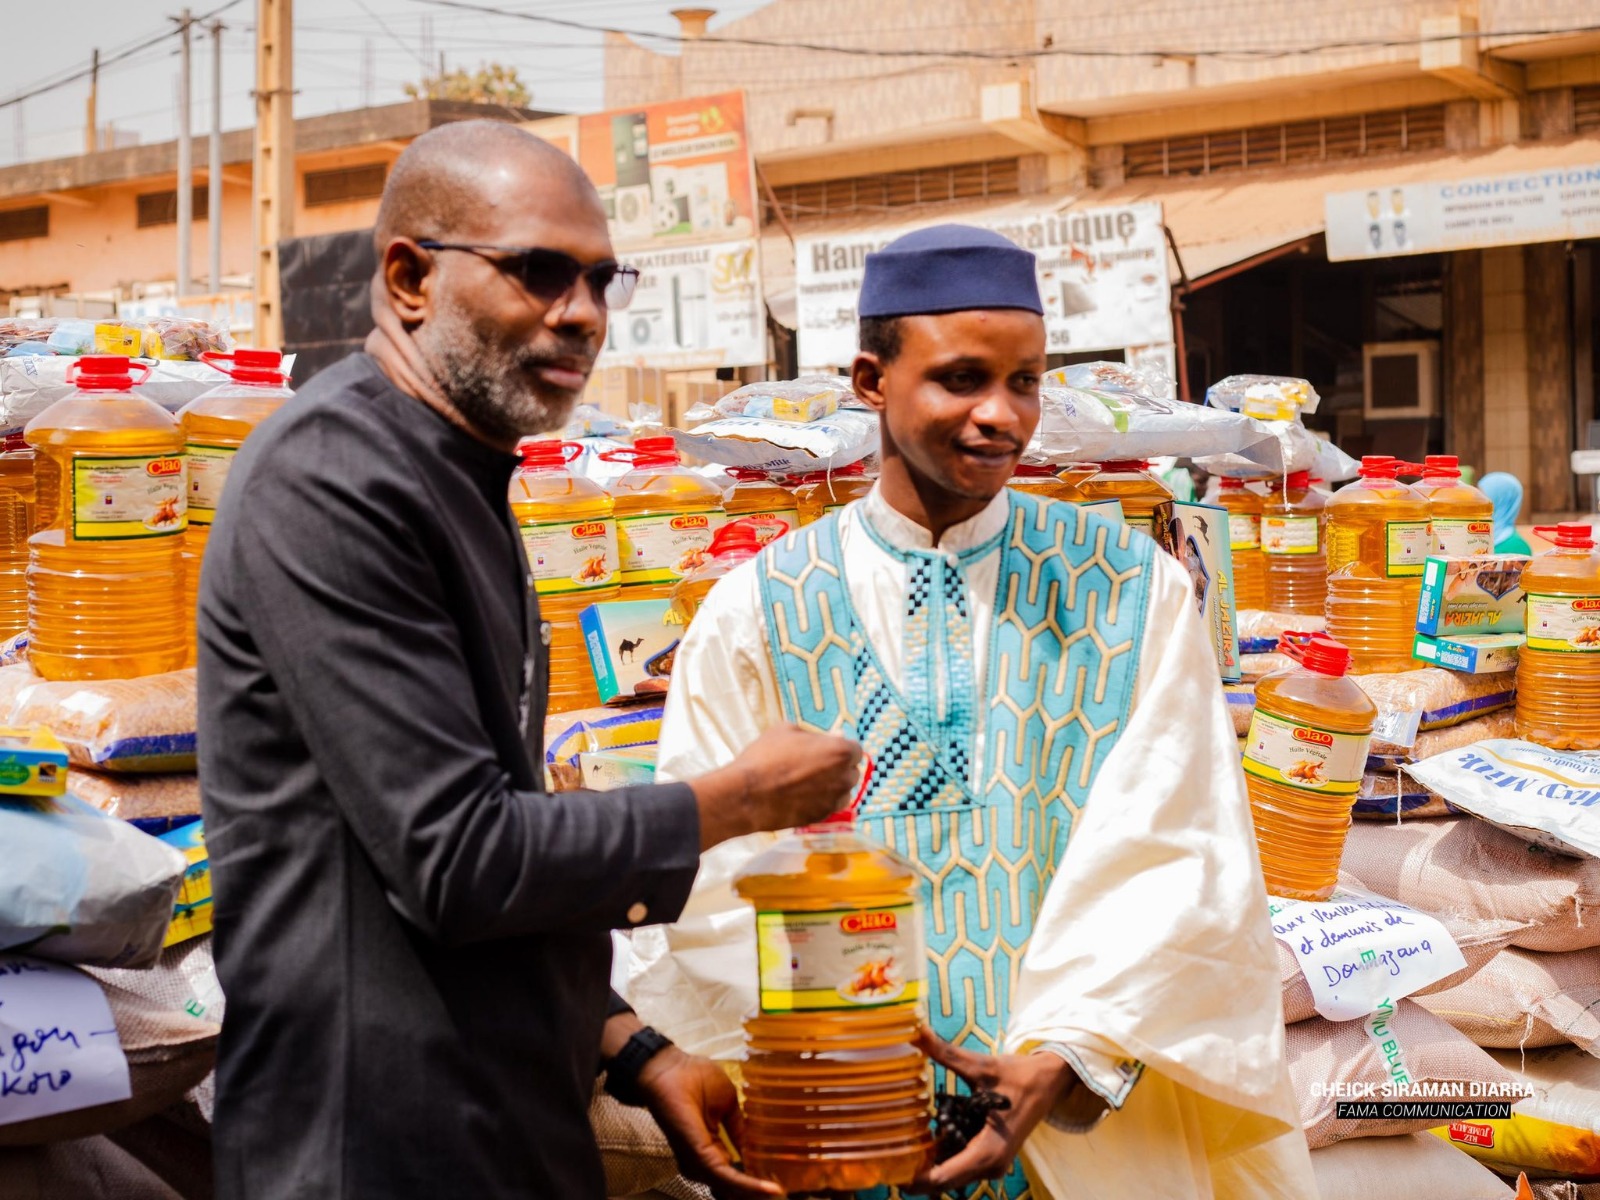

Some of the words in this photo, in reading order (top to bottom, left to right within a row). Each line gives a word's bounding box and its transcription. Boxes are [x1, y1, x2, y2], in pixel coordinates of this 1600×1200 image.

[812, 242, 889, 274] Ham
[148, 458, 181, 475] Ciao
[573, 522, 605, 537] Ciao
[672, 514, 708, 530] Ciao
[1217, 570, 1229, 595] AL
[662, 608, 683, 626] AL
[1444, 610, 1485, 627] JAZIRA
[1487, 610, 1502, 625] AL
[1219, 599, 1235, 667] JAZIRA
[1295, 727, 1331, 743] Ciao
[1458, 753, 1538, 793] Milk
[1543, 756, 1588, 773] Poudre
[1451, 1122, 1490, 1138] JUMEAUX
[1463, 1133, 1478, 1143] RIZ
